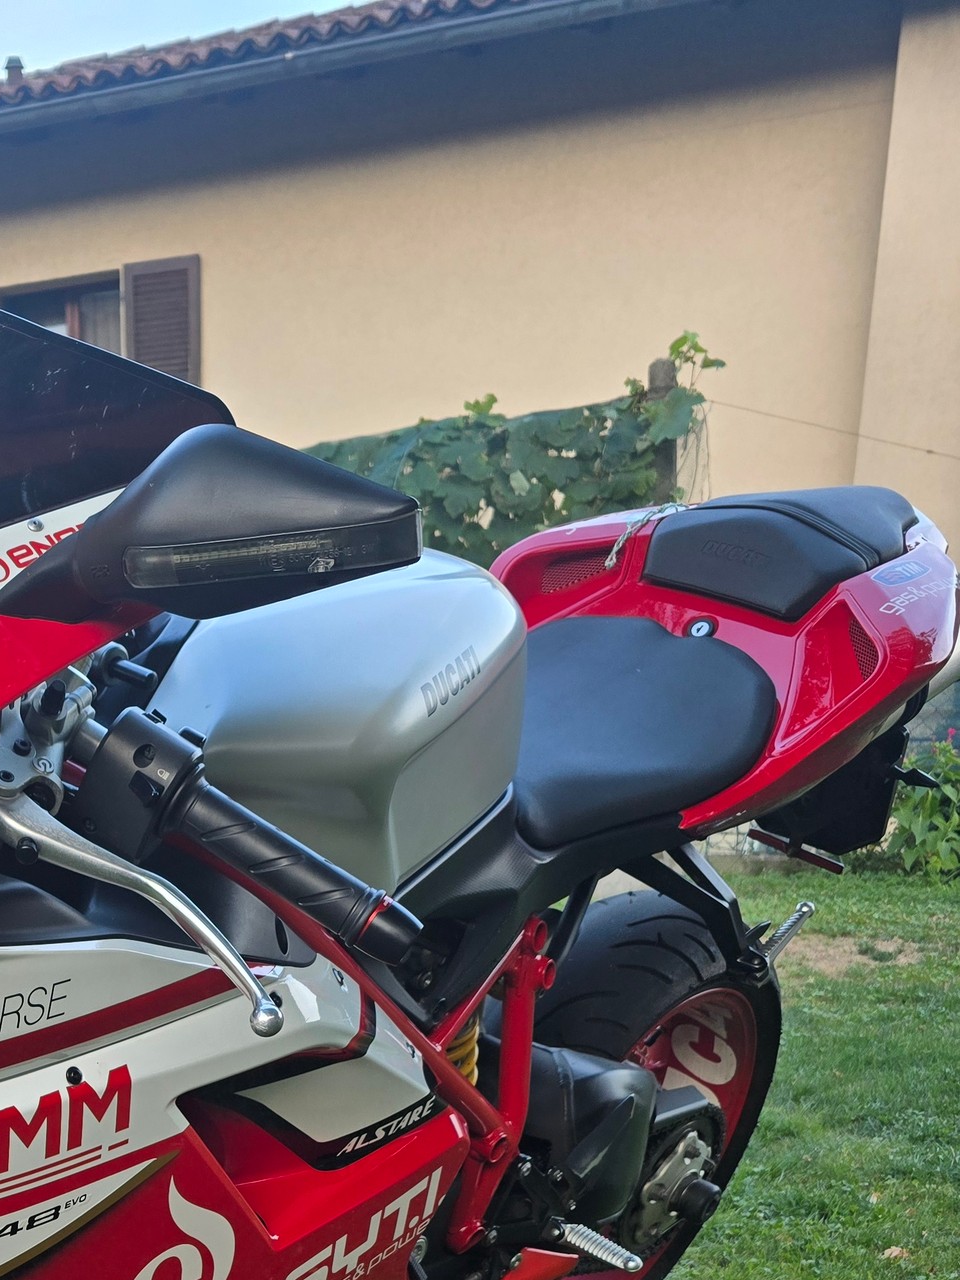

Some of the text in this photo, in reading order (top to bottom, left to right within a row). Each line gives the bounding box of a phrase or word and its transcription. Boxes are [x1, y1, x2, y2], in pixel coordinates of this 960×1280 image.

[421, 645, 482, 718] DUCATI
[336, 1095, 436, 1157] ALSTARE
[64, 1193, 88, 1210] EVO
